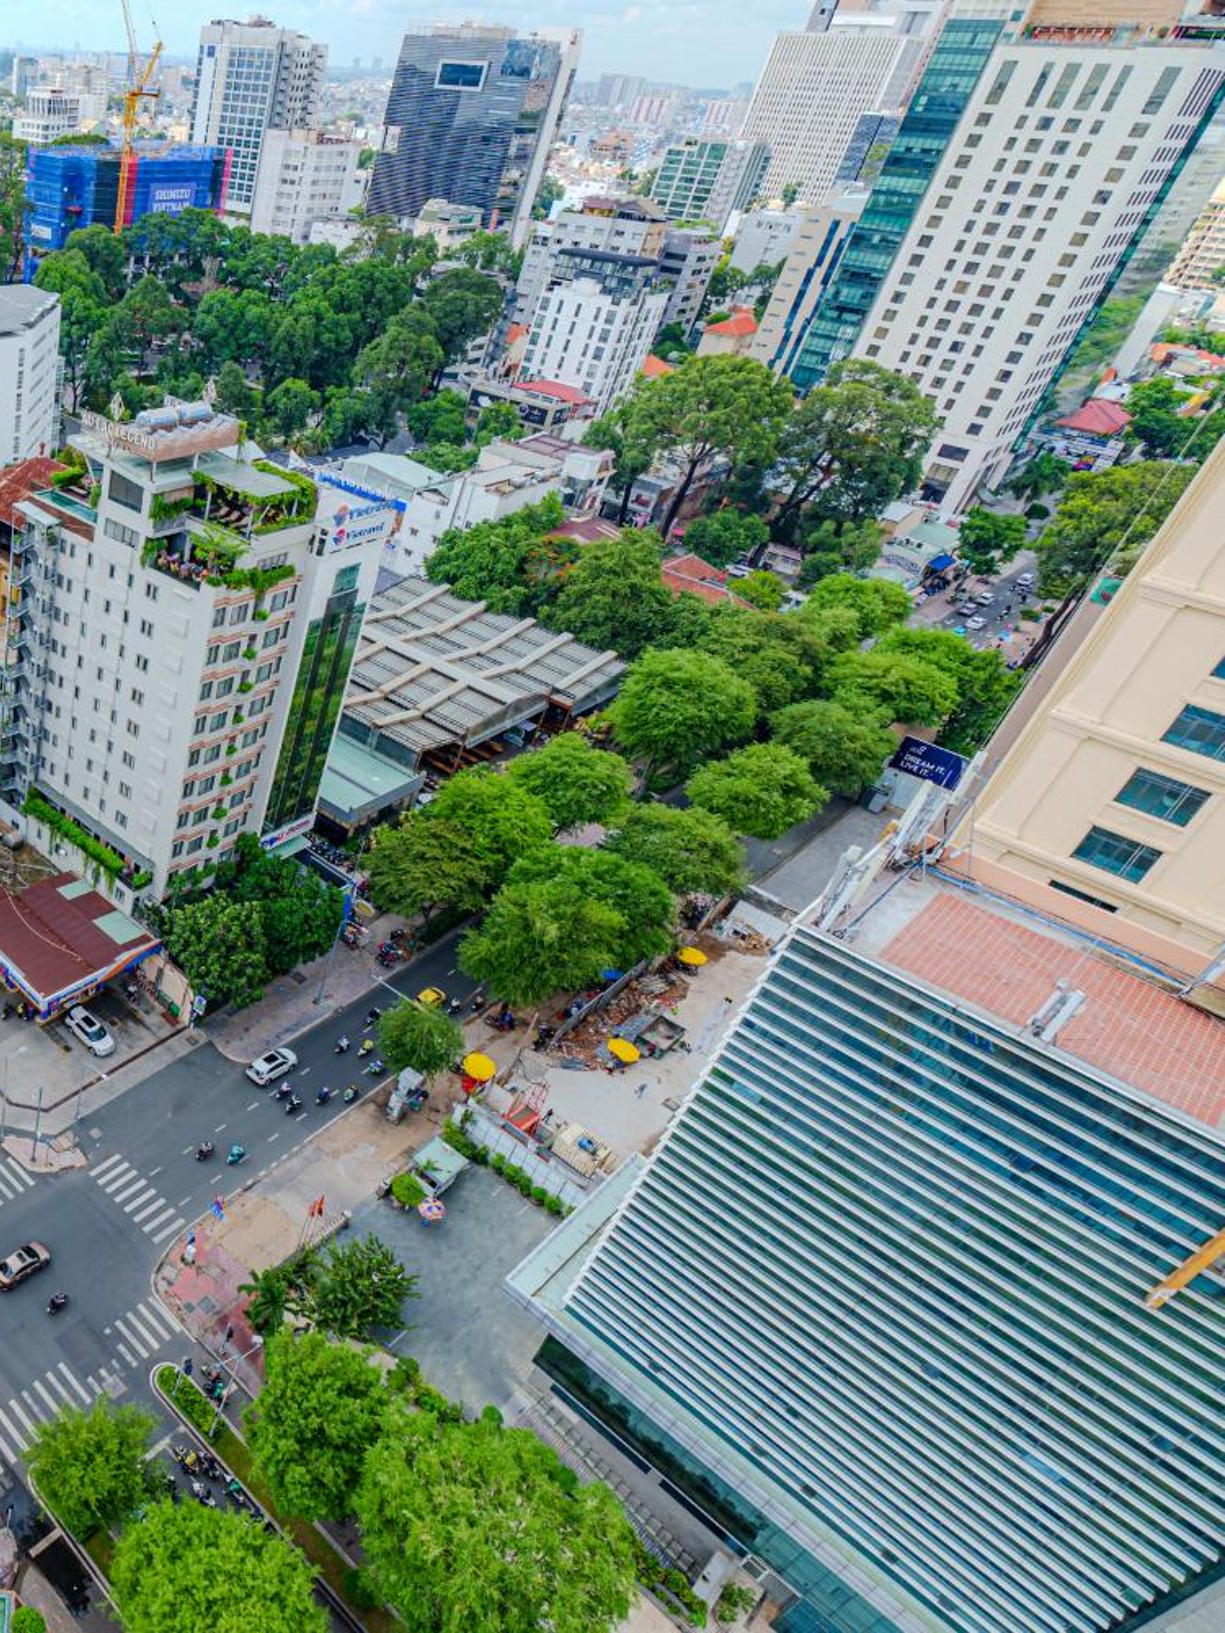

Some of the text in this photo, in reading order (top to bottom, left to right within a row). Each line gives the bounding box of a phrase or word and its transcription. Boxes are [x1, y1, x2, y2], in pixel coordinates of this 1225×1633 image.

[154, 189, 191, 201] SHIMIZU
[115, 423, 155, 450] LEGEND
[900, 760, 919, 773] LIVE
[903, 753, 936, 770] DREAM
